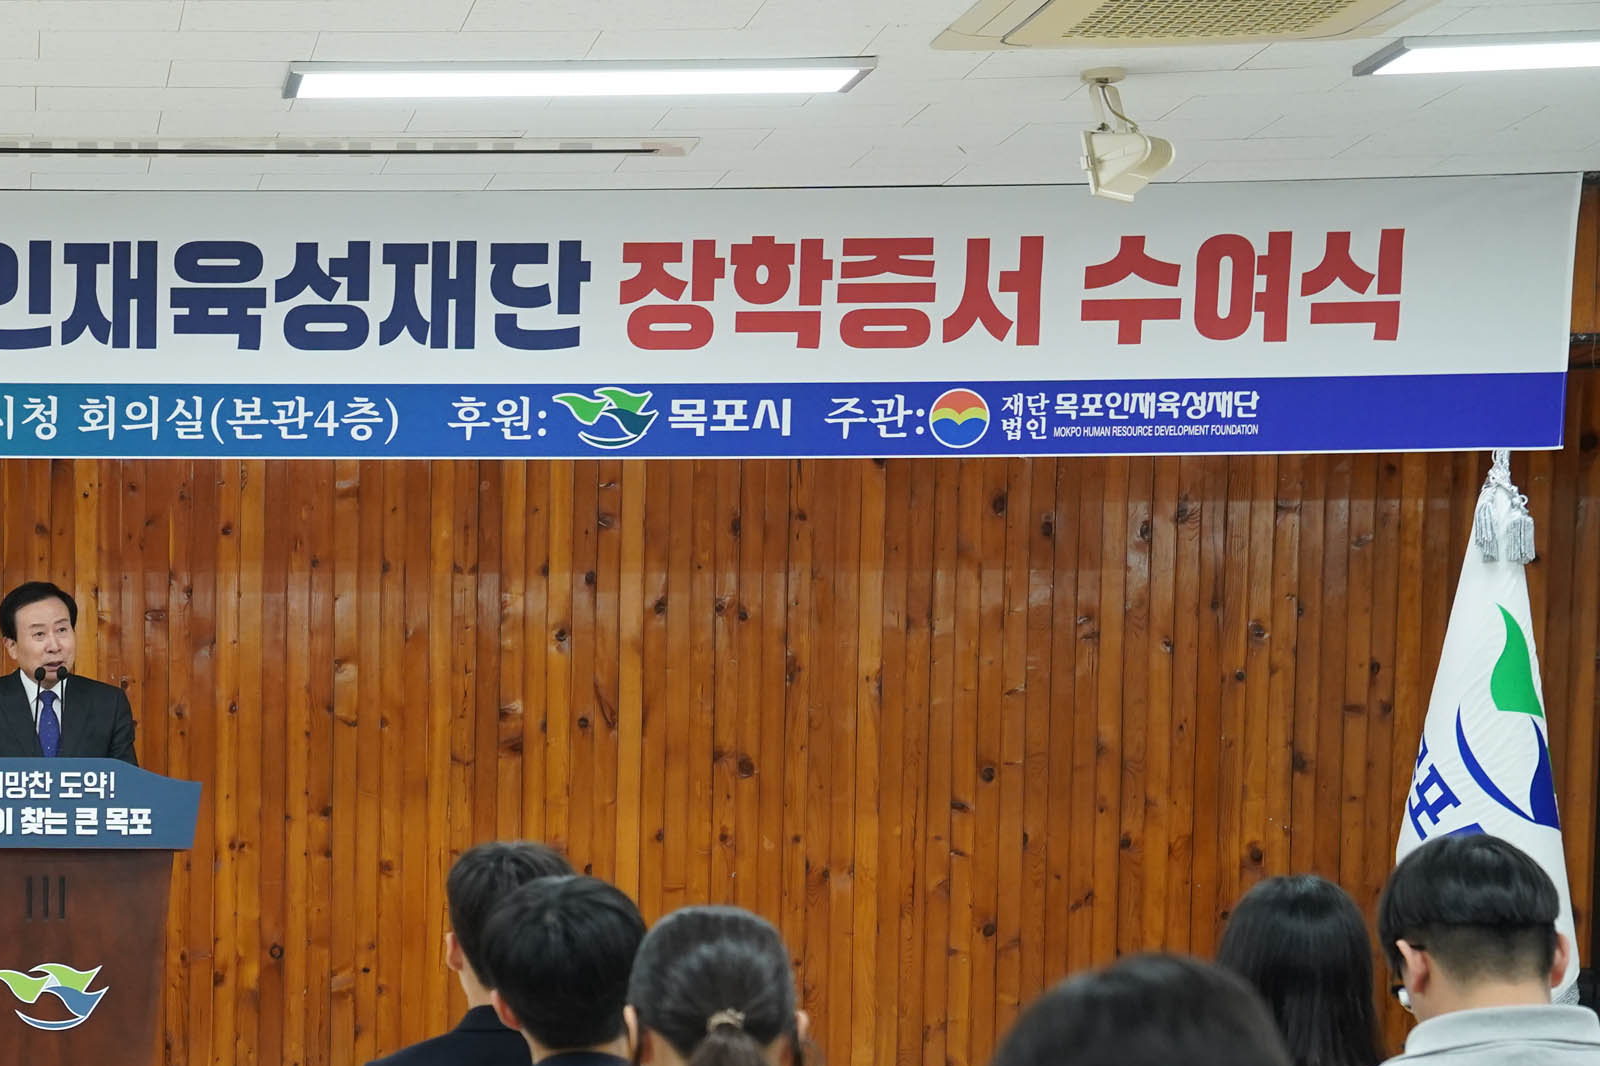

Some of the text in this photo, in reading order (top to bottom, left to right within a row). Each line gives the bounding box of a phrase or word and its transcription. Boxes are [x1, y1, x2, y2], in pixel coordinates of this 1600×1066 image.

[620, 235, 1045, 351] 장학증서
[1081, 228, 1406, 345] 수여식
[668, 398, 792, 437] 목포시
[824, 394, 925, 440] 주관:
[1001, 392, 1050, 416] 재단
[1054, 390, 1260, 420] 목포인재육성재단
[78, 395, 399, 445] 회의실(본관4층)
[447, 395, 547, 441] 후원:
[1001, 417, 1047, 441] 법인
[1053, 423, 1259, 438] MOKPO HUMAN RESOURCE DEVELOPMENT FOUNDATION
[58, 771, 115, 799] 도약!
[20, 806, 68, 835] 찾는
[74, 807, 99, 835] 큰
[105, 807, 152, 836] 목포
